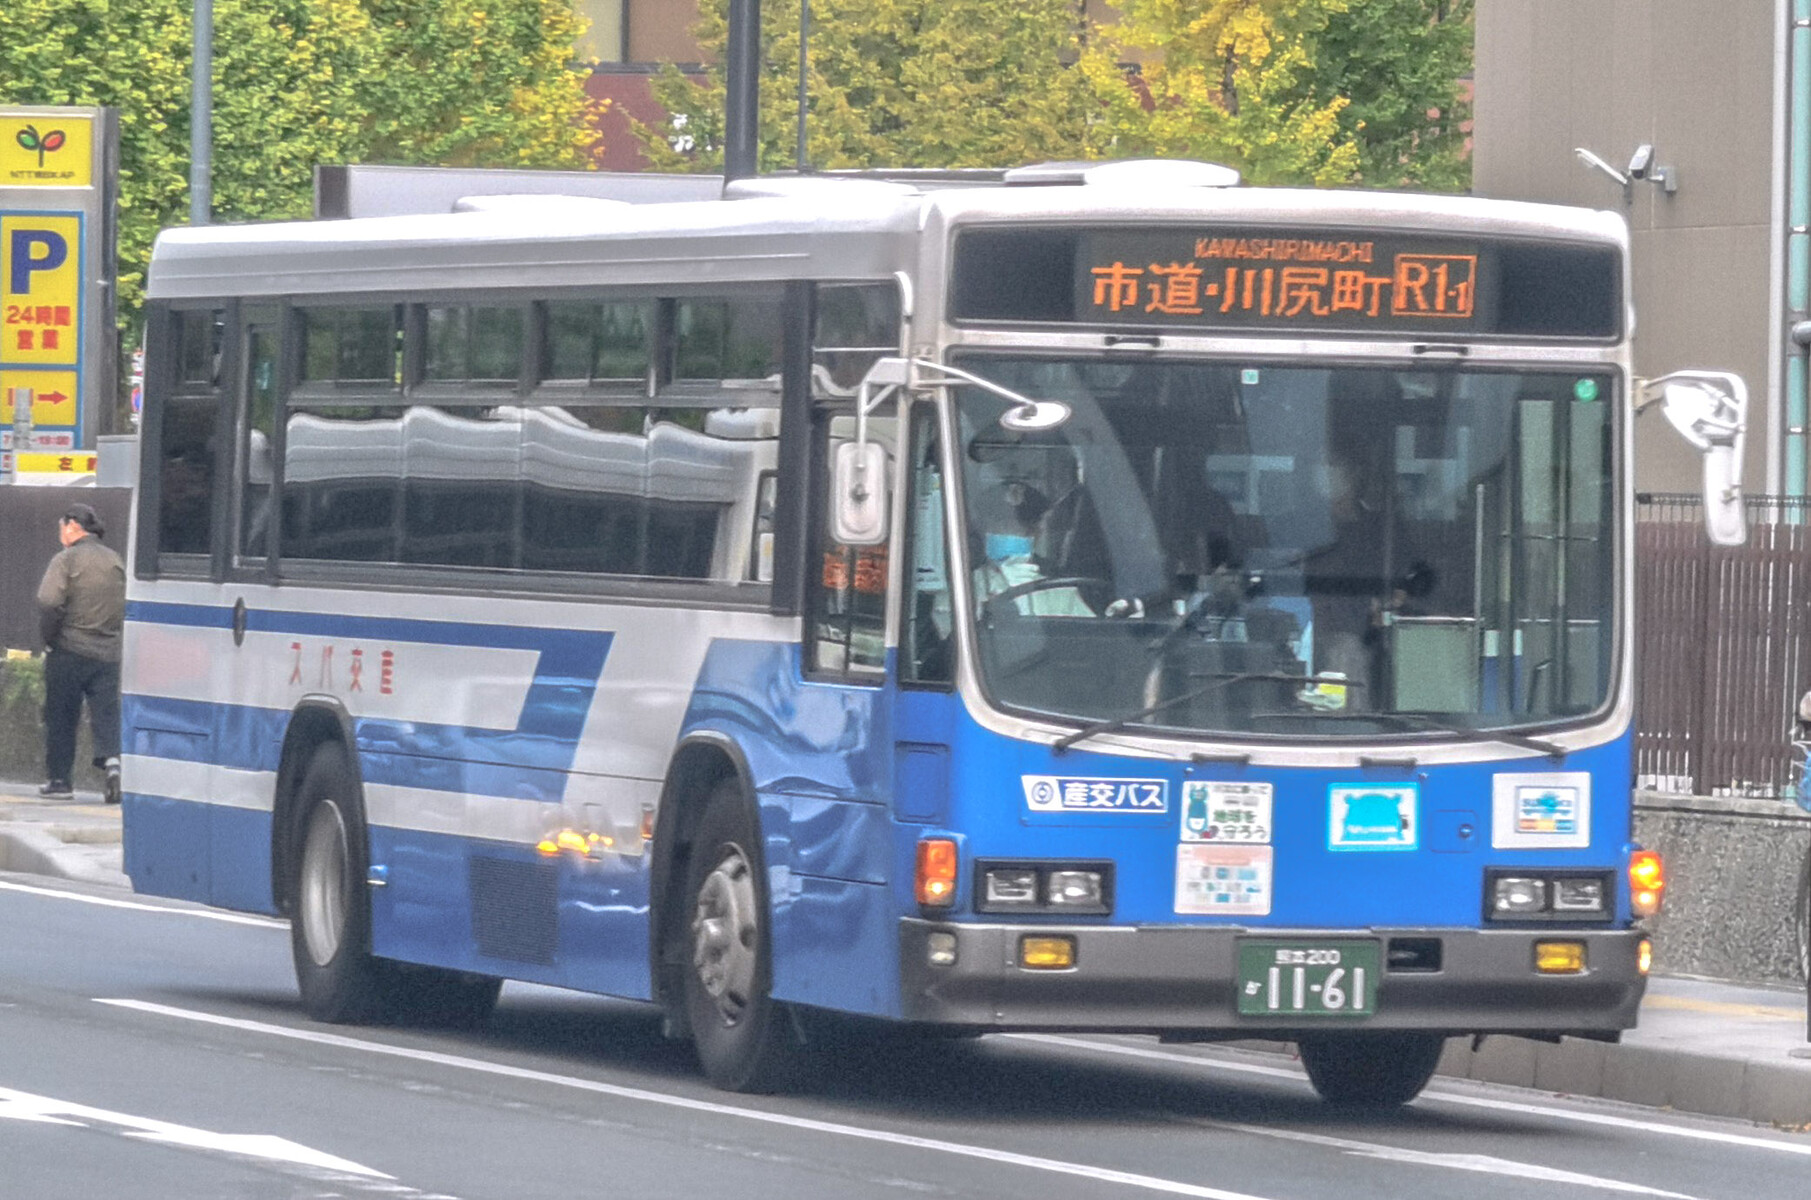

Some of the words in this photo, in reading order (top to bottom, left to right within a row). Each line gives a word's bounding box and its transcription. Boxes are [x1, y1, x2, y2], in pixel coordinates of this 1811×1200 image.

[10, 229, 68, 294] P
[1064, 782, 1163, 807] 産交バス
[1268, 967, 1364, 1009] 11-61
